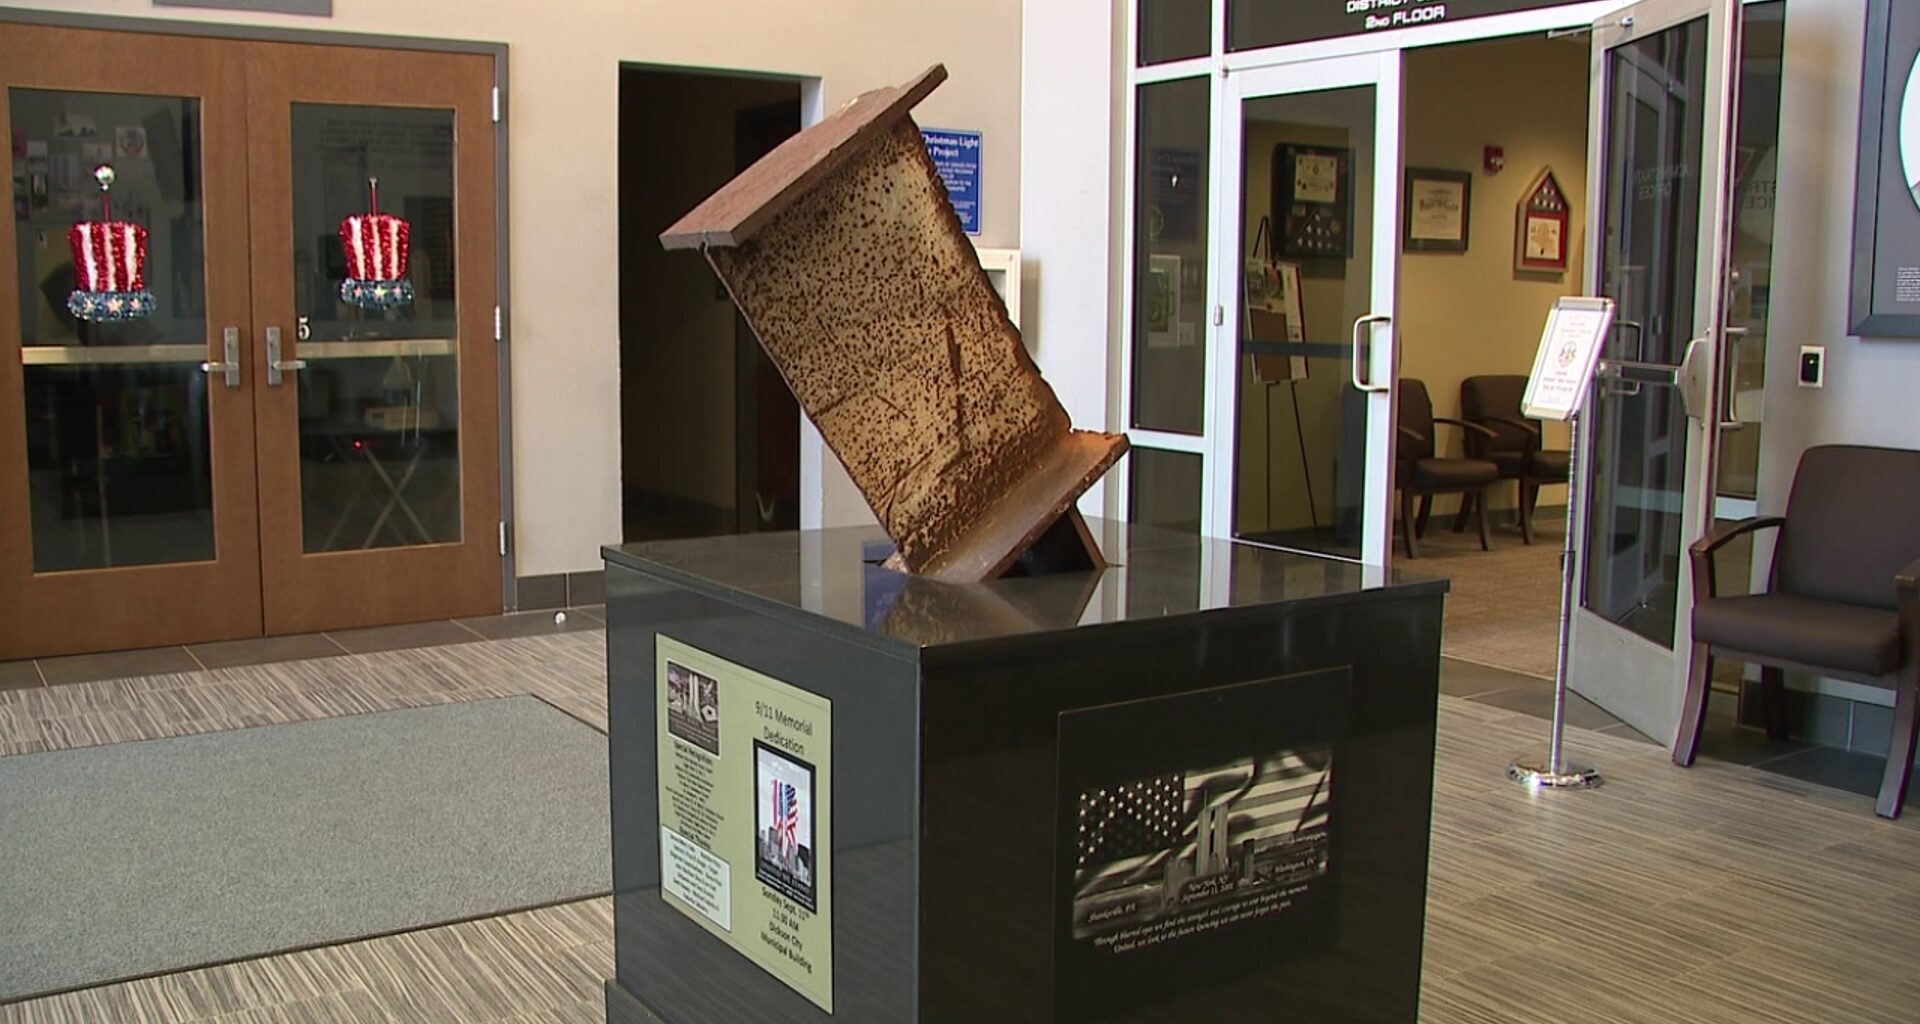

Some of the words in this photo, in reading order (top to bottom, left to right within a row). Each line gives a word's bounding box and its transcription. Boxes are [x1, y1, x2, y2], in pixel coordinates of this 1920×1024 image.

[1392, 5, 1446, 26] FLOOR
[933, 146, 959, 159] Project
[959, 136, 979, 150] Light
[298, 315, 310, 340] 5
[755, 700, 773, 720] 9/11
[774, 708, 813, 737] Memorial
[763, 725, 805, 756] Dedication
[761, 886, 782, 907] Sunday
[768, 921, 790, 942] Dickson
[791, 935, 803, 952] City
[760, 931, 787, 957] Municipal
[788, 948, 813, 975] Building
